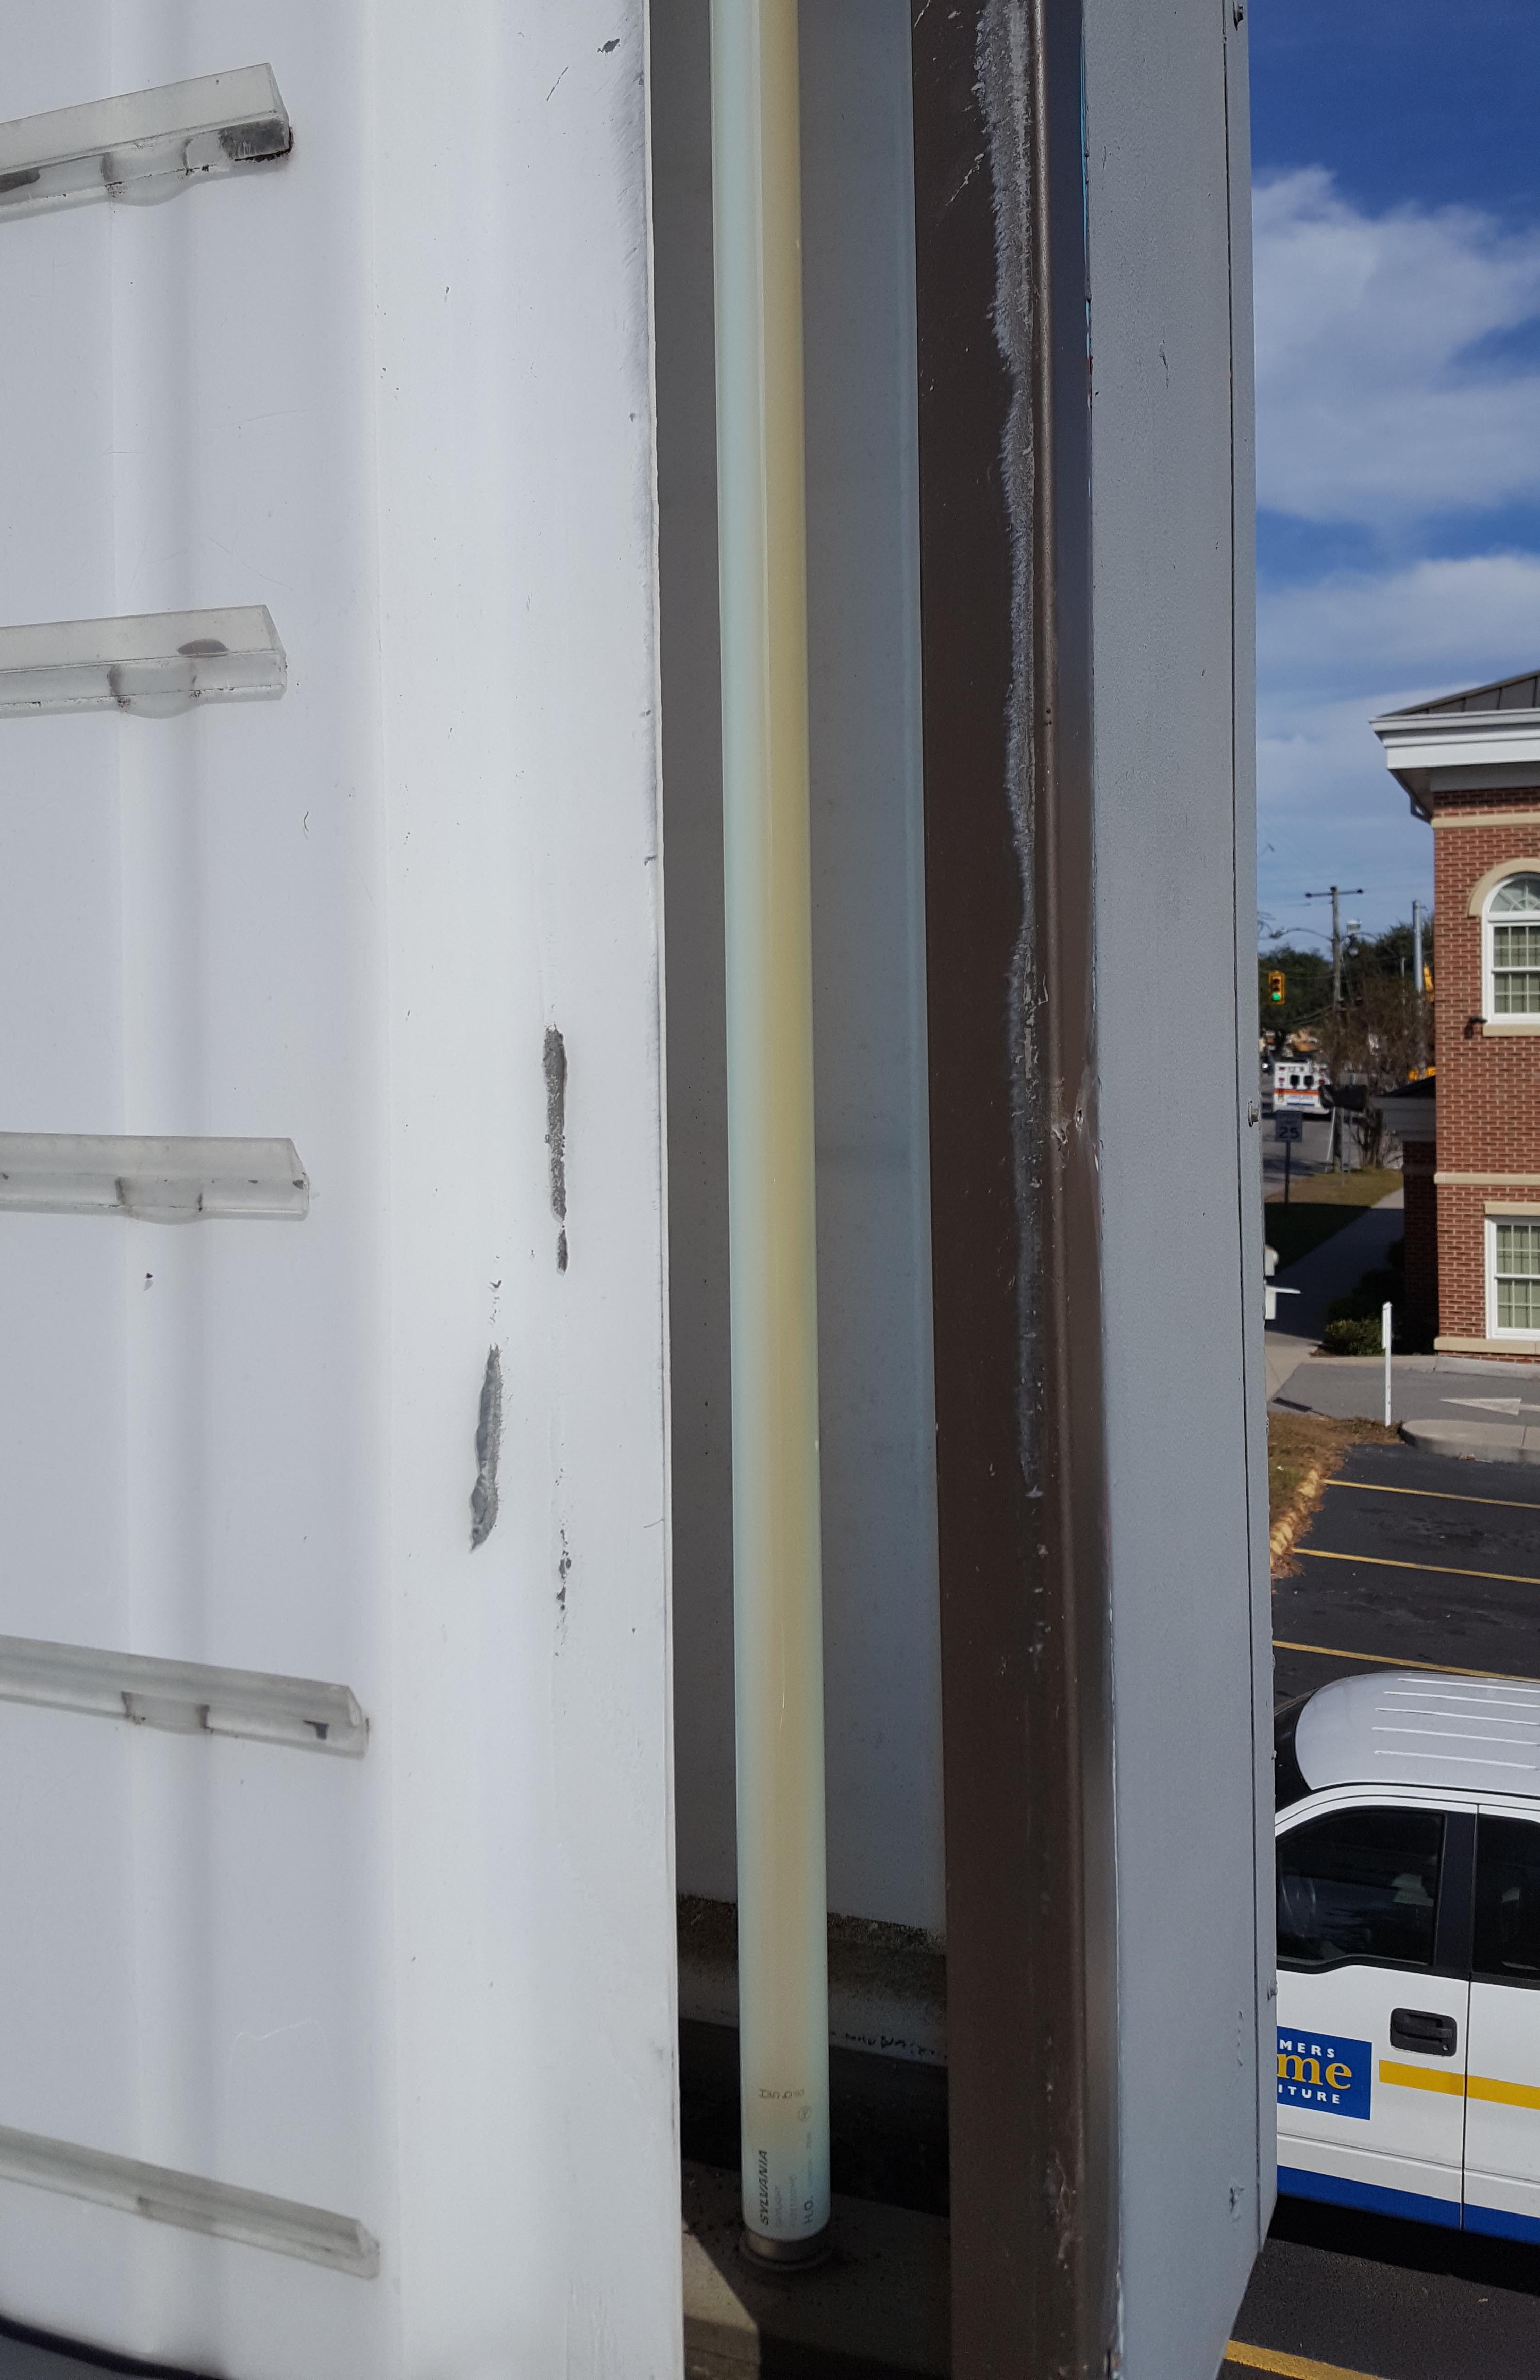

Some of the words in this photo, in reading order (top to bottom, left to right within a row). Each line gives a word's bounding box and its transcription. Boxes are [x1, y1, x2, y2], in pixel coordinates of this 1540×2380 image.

[1279, 1127, 1299, 1139] 25
[1279, 2039, 1335, 2058] MERS
[1277, 2053, 1352, 2090] me
[1278, 2084, 1341, 2104] ITURE
[758, 2149, 769, 2226] SYLVANIA
